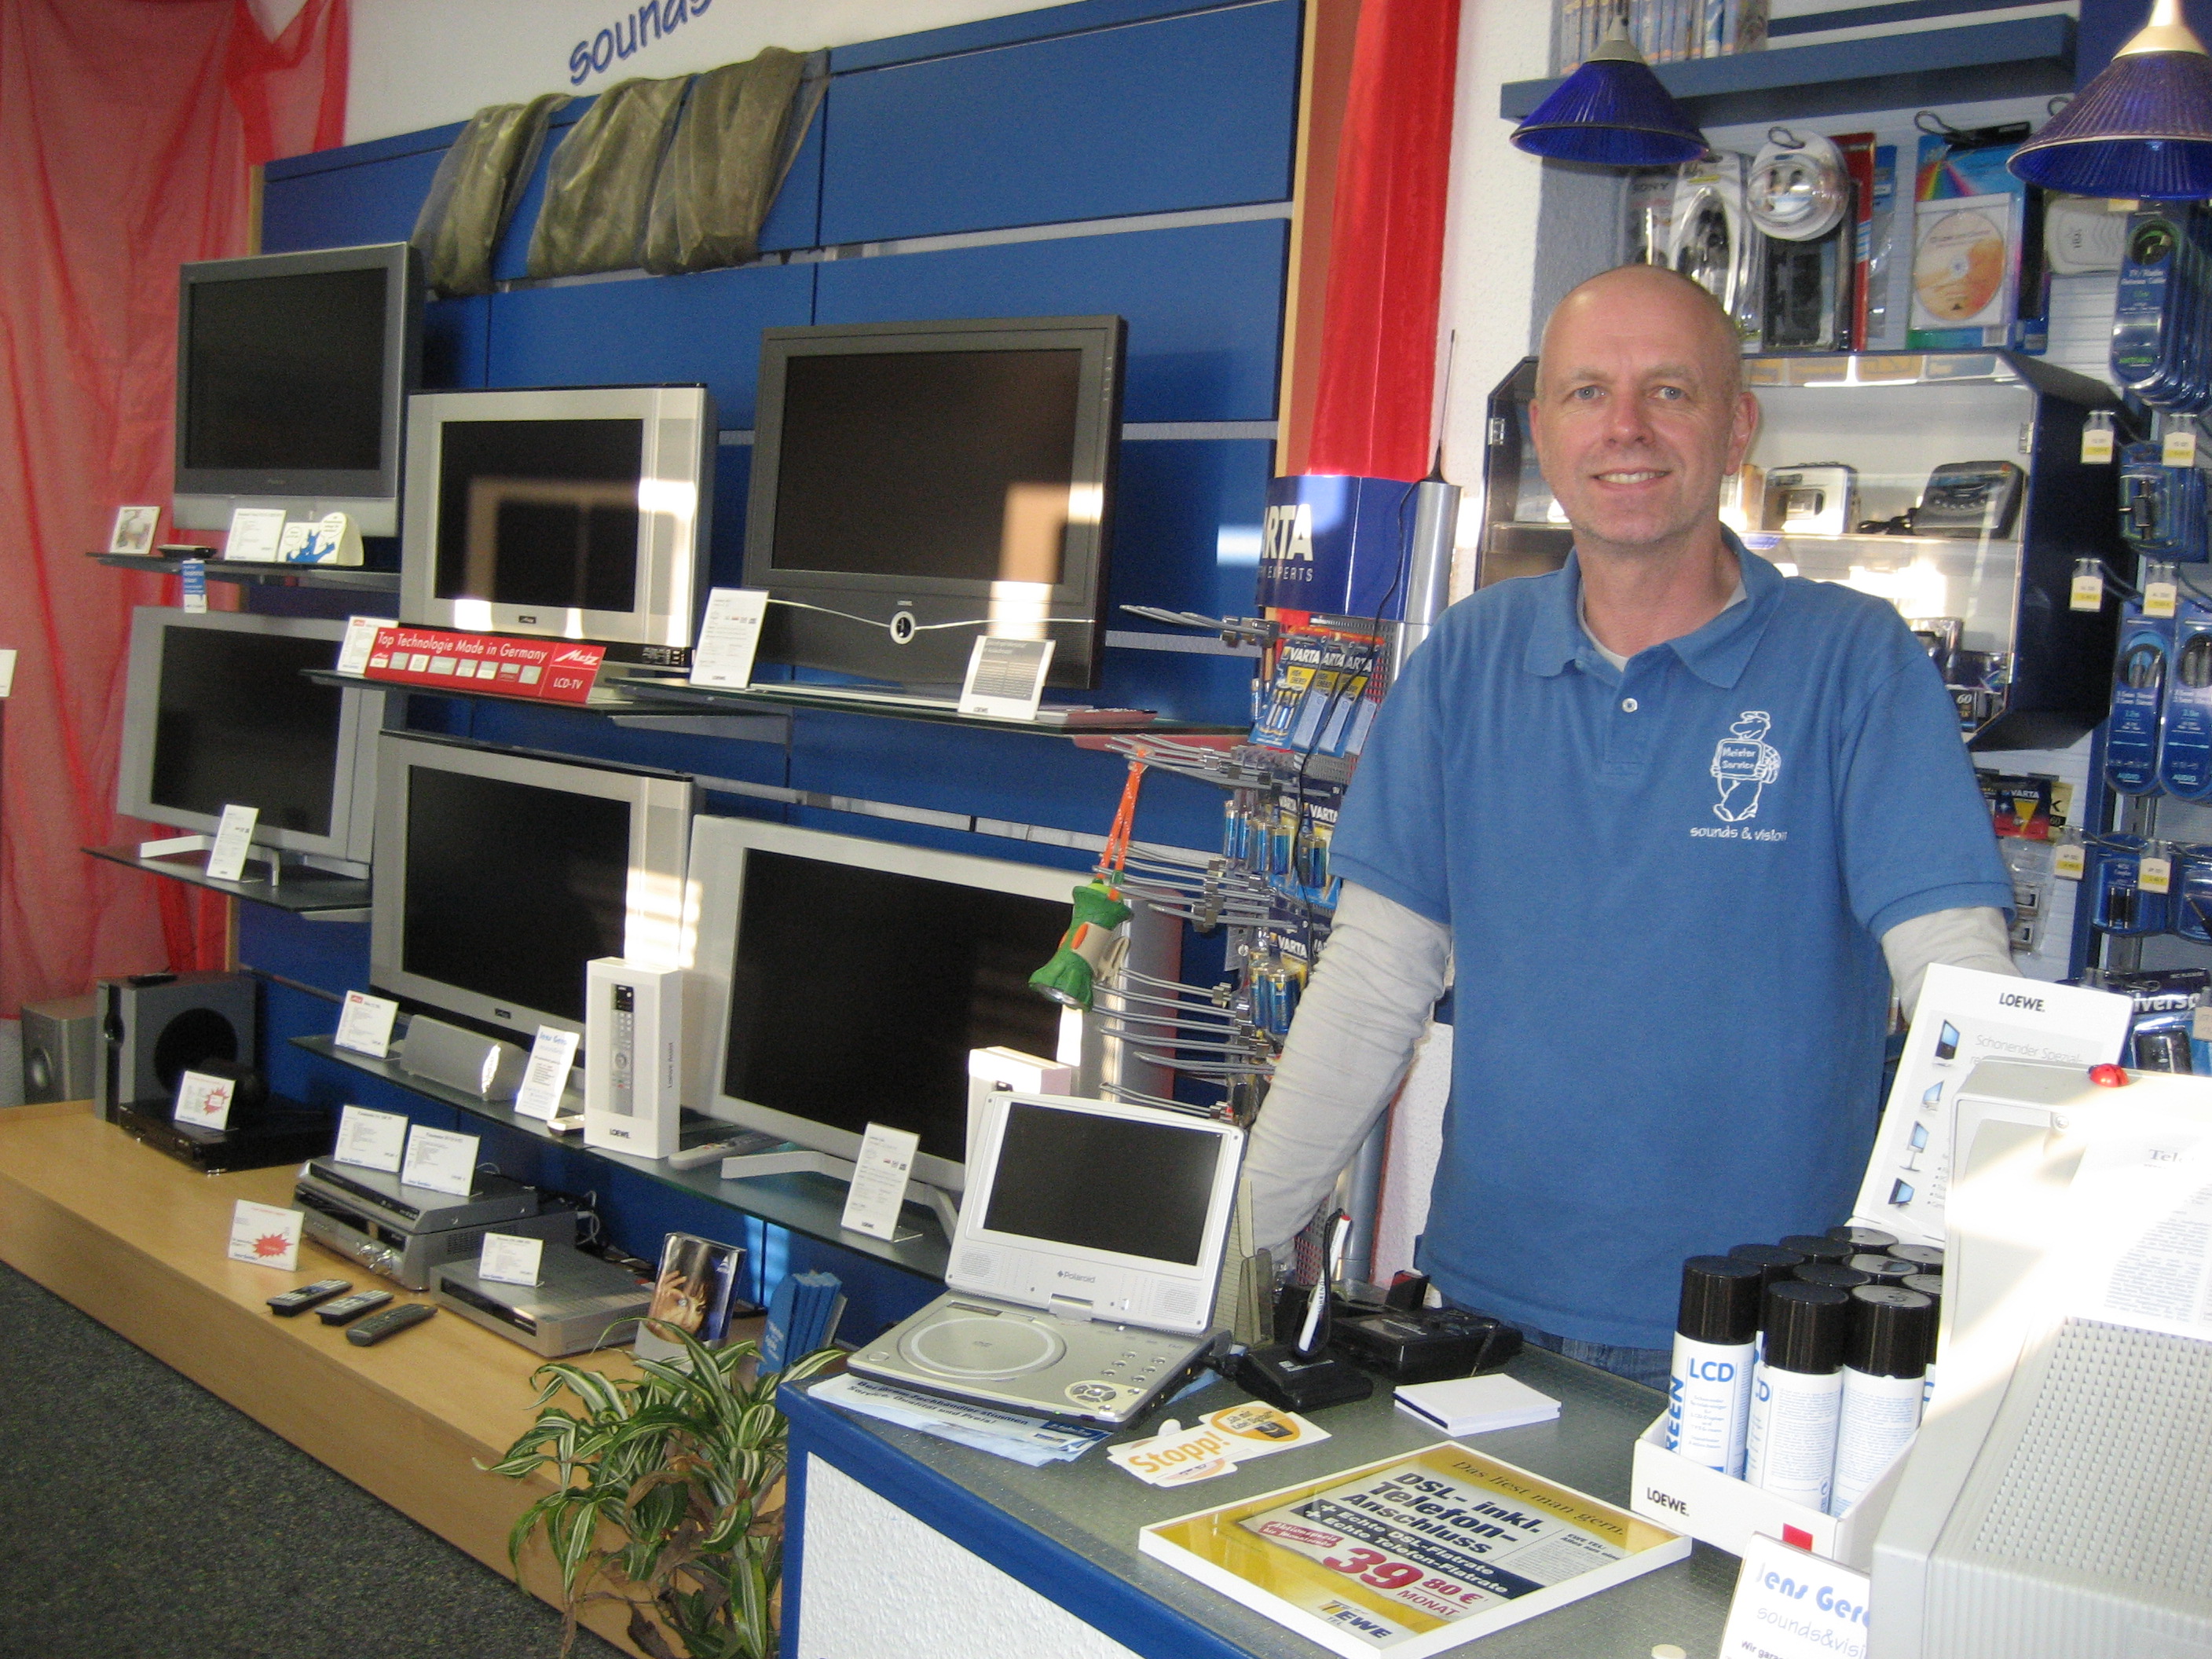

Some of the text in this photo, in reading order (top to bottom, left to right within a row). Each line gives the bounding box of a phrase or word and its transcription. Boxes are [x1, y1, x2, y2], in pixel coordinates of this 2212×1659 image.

[1262, 504, 1314, 561] RTA
[378, 631, 549, 664] Top Technologie Made in Germany
[555, 649, 602, 666] Metz
[1290, 646, 1321, 665] VARTA
[1321, 652, 1345, 668] ARTA
[1344, 657, 1373, 673] ARTA
[553, 677, 584, 690] LCD-TV
[1957, 694, 1973, 705] 60
[1722, 760, 1755, 770] Service
[1723, 747, 1756, 758] Meister
[2011, 789, 2040, 799] VARTA
[1690, 826, 1738, 838] sounds
[1741, 826, 1752, 840] &
[1278, 935, 1308, 958] VARTA
[2133, 992, 2201, 1012] iversa
[1976, 1035, 2083, 1064] Schonender Spezial-
[1064, 1271, 1096, 1284] Polaroid
[1690, 1357, 1734, 1382] LCD
[1666, 1376, 1684, 1452] REEN
[1128, 1430, 1231, 1473] Stopp!
[1369, 1481, 1519, 1542] Telefon-
[1393, 1472, 1545, 1534] DSL- inkl.
[1452, 1460, 1624, 1536] Das liest man gern.
[1339, 1494, 1493, 1553] Anschluss
[1325, 1516, 1370, 1540] Echte
[1375, 1536, 1508, 1593] Telefon-Flatrate
[1336, 1509, 1386, 1533] Echte
[1386, 1530, 1495, 1576] DSL-Flatrate
[1323, 1547, 1484, 1605] 39 80 €
[1755, 1562, 1809, 1600] Jens
[1397, 1589, 1461, 1617] MONAT
[1334, 1610, 1393, 1639] EWE
[1757, 1607, 1868, 1659] sounds&visi
[1741, 1640, 1756, 1653] Wir
